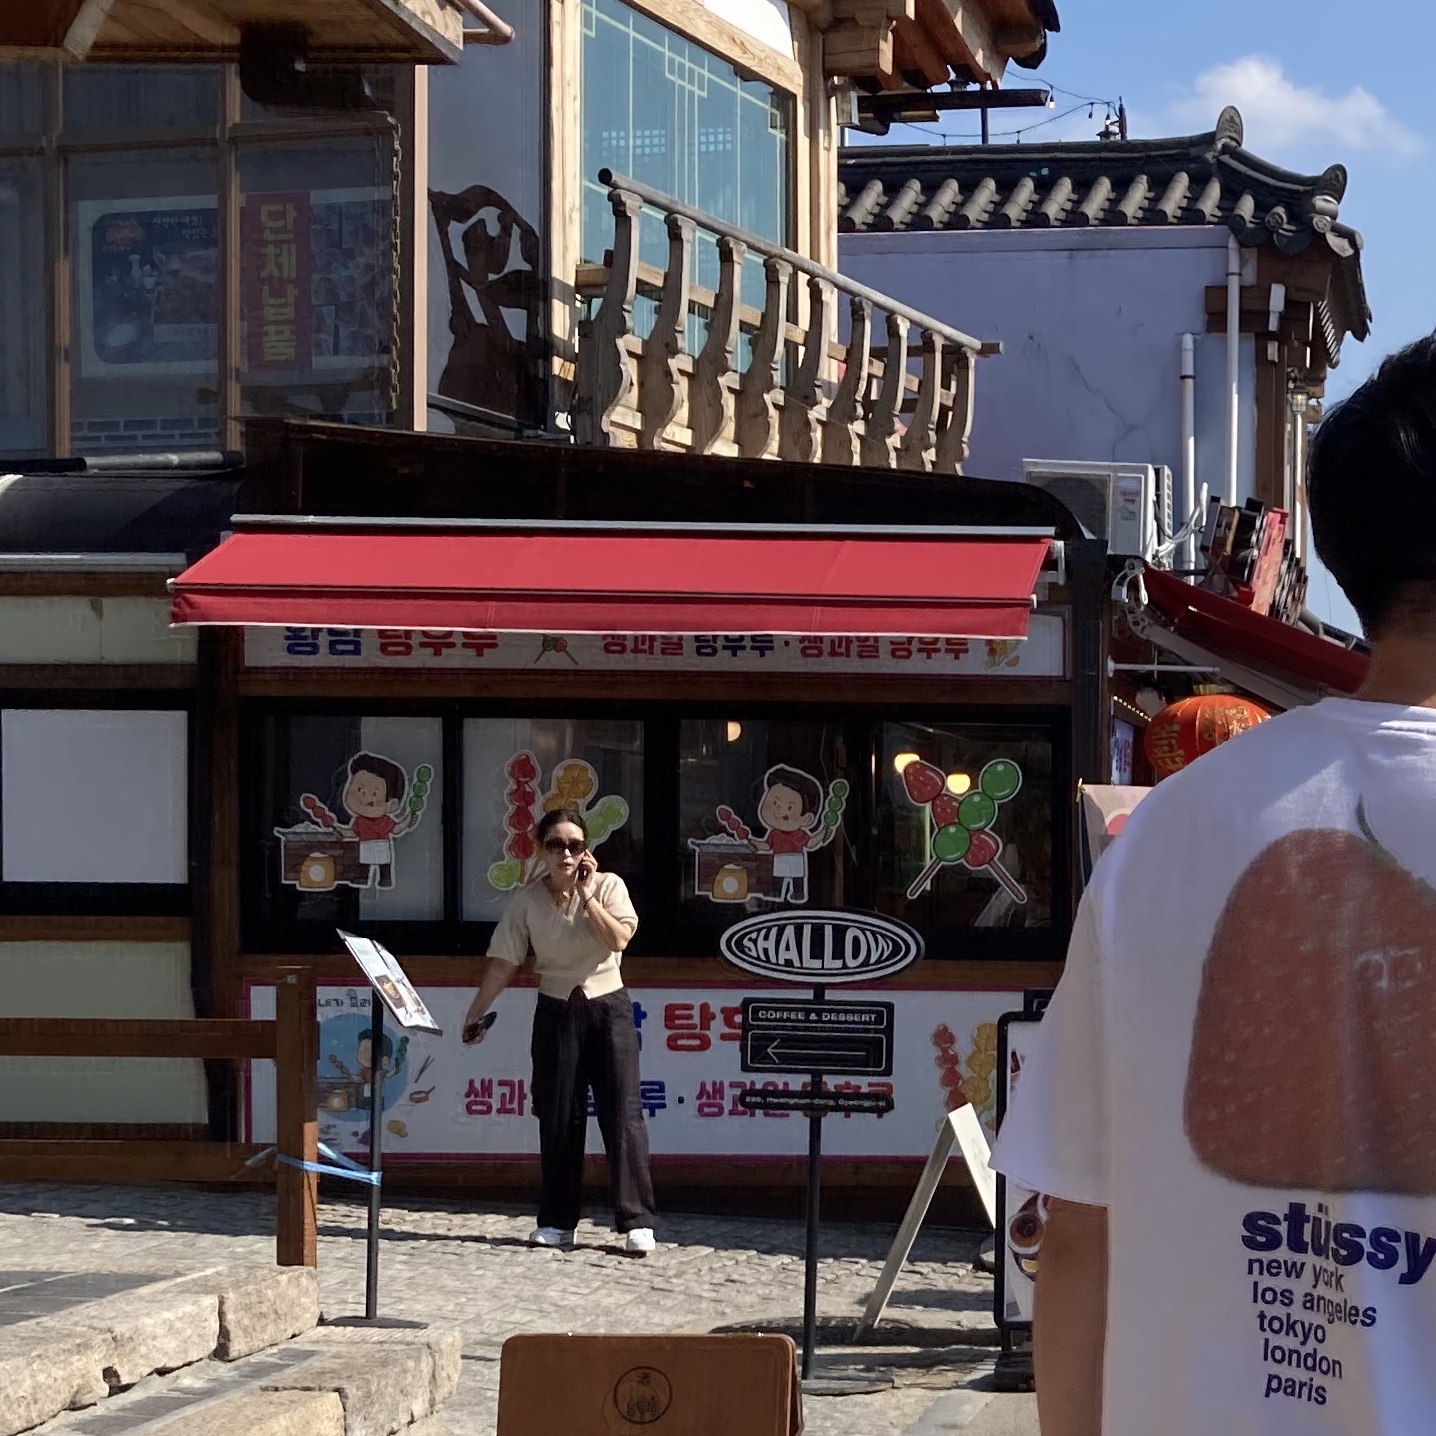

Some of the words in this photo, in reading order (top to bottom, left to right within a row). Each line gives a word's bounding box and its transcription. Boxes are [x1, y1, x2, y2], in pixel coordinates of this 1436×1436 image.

[742, 923, 893, 969] SHALLOW
[758, 1010, 805, 1021] COFFEE
[808, 1012, 819, 1021] &
[821, 1012, 878, 1023] DESSERT
[464, 1078, 533, 1116] 생과
[1247, 1257, 1305, 1279] new
[1312, 1264, 1345, 1292] york
[1252, 1281, 1294, 1307] los
[1302, 1291, 1377, 1328] angeles
[1257, 1310, 1326, 1346] tokyo
[1262, 1338, 1343, 1379] london
[1264, 1373, 1328, 1405] paris
